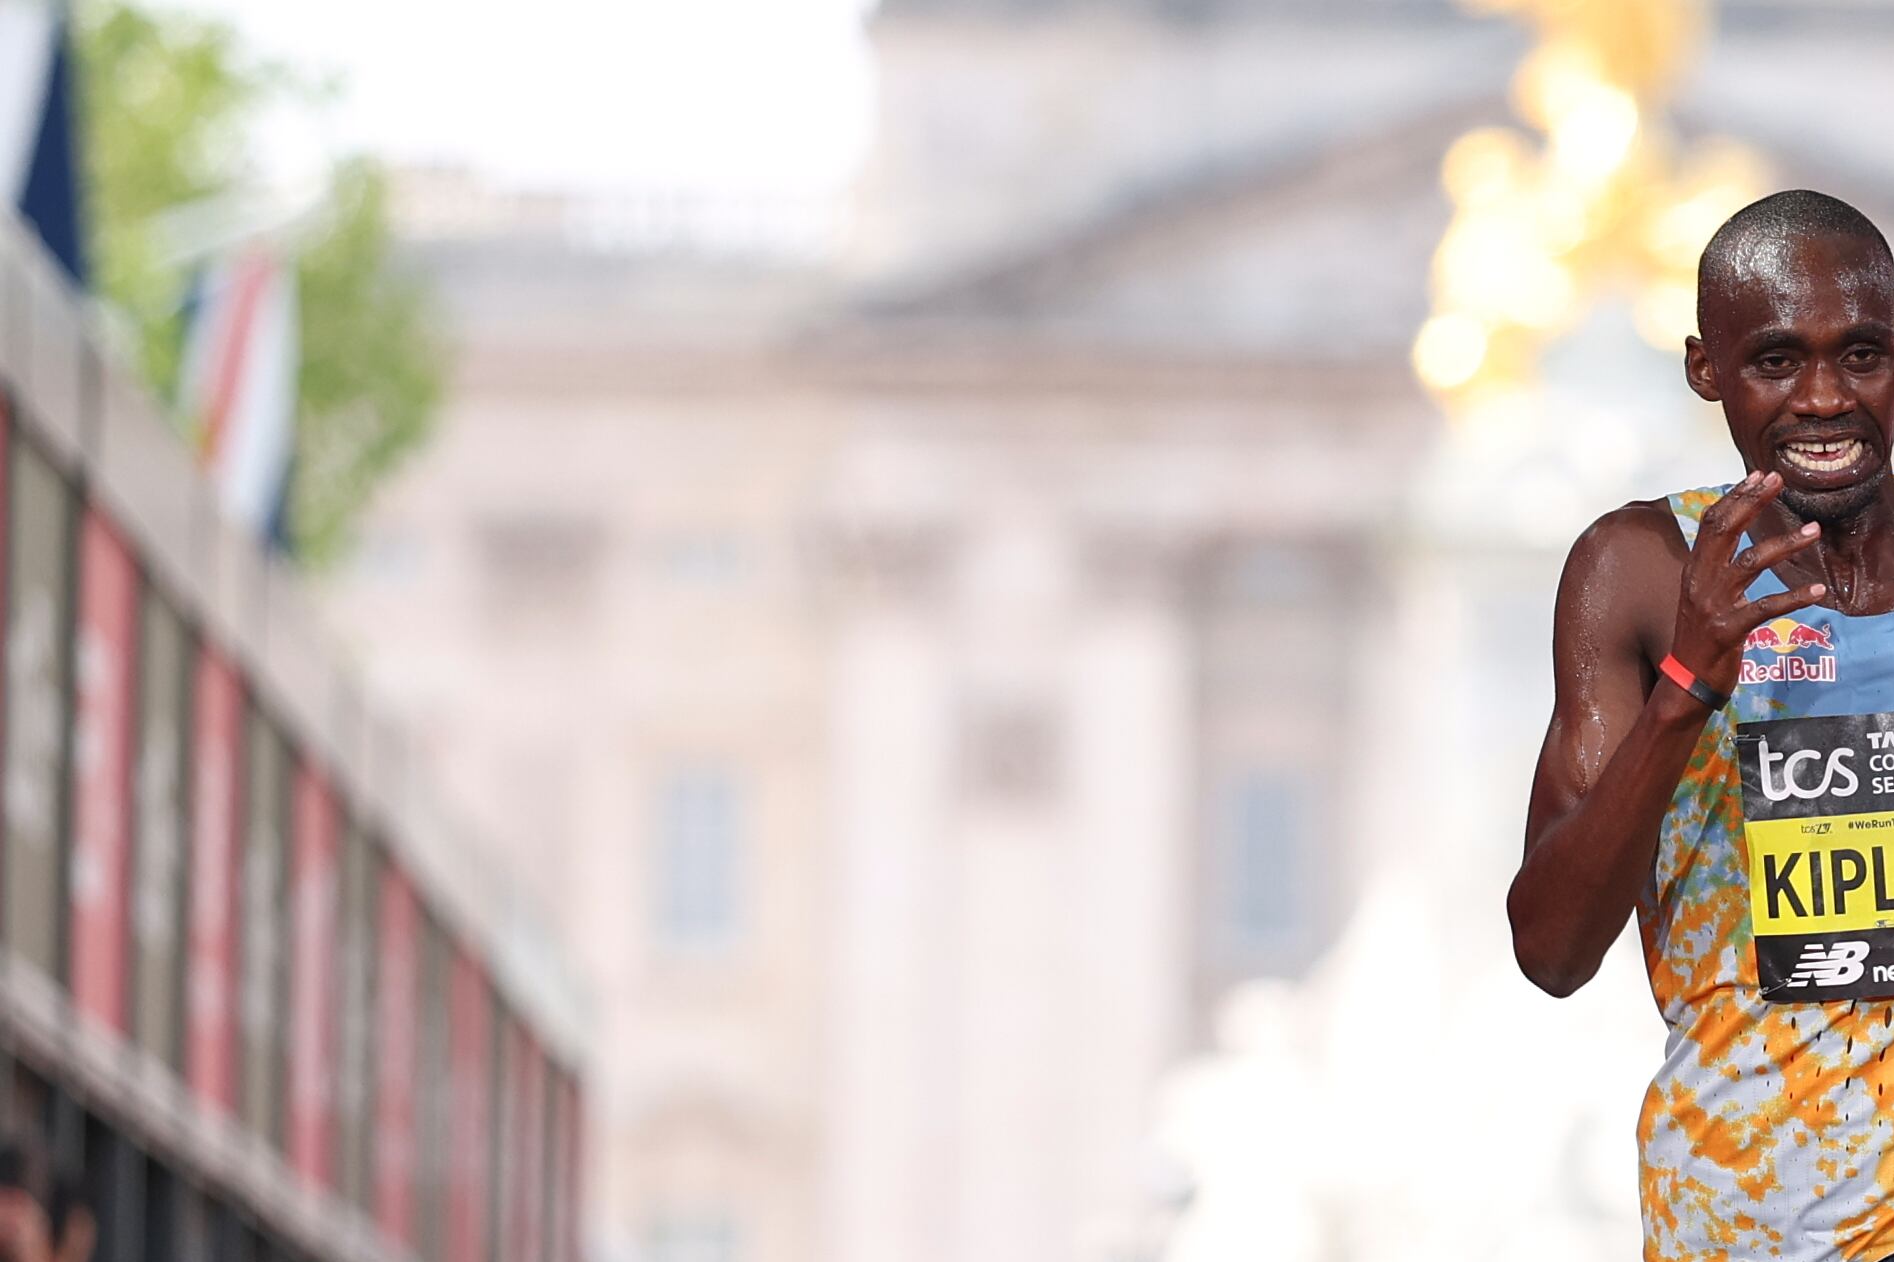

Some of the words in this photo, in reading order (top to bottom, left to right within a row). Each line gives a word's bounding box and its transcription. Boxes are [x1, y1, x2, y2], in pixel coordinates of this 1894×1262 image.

[1739, 656, 1785, 684] Red
[1787, 656, 1835, 682] Bull
[1758, 740, 1859, 802] tcs
